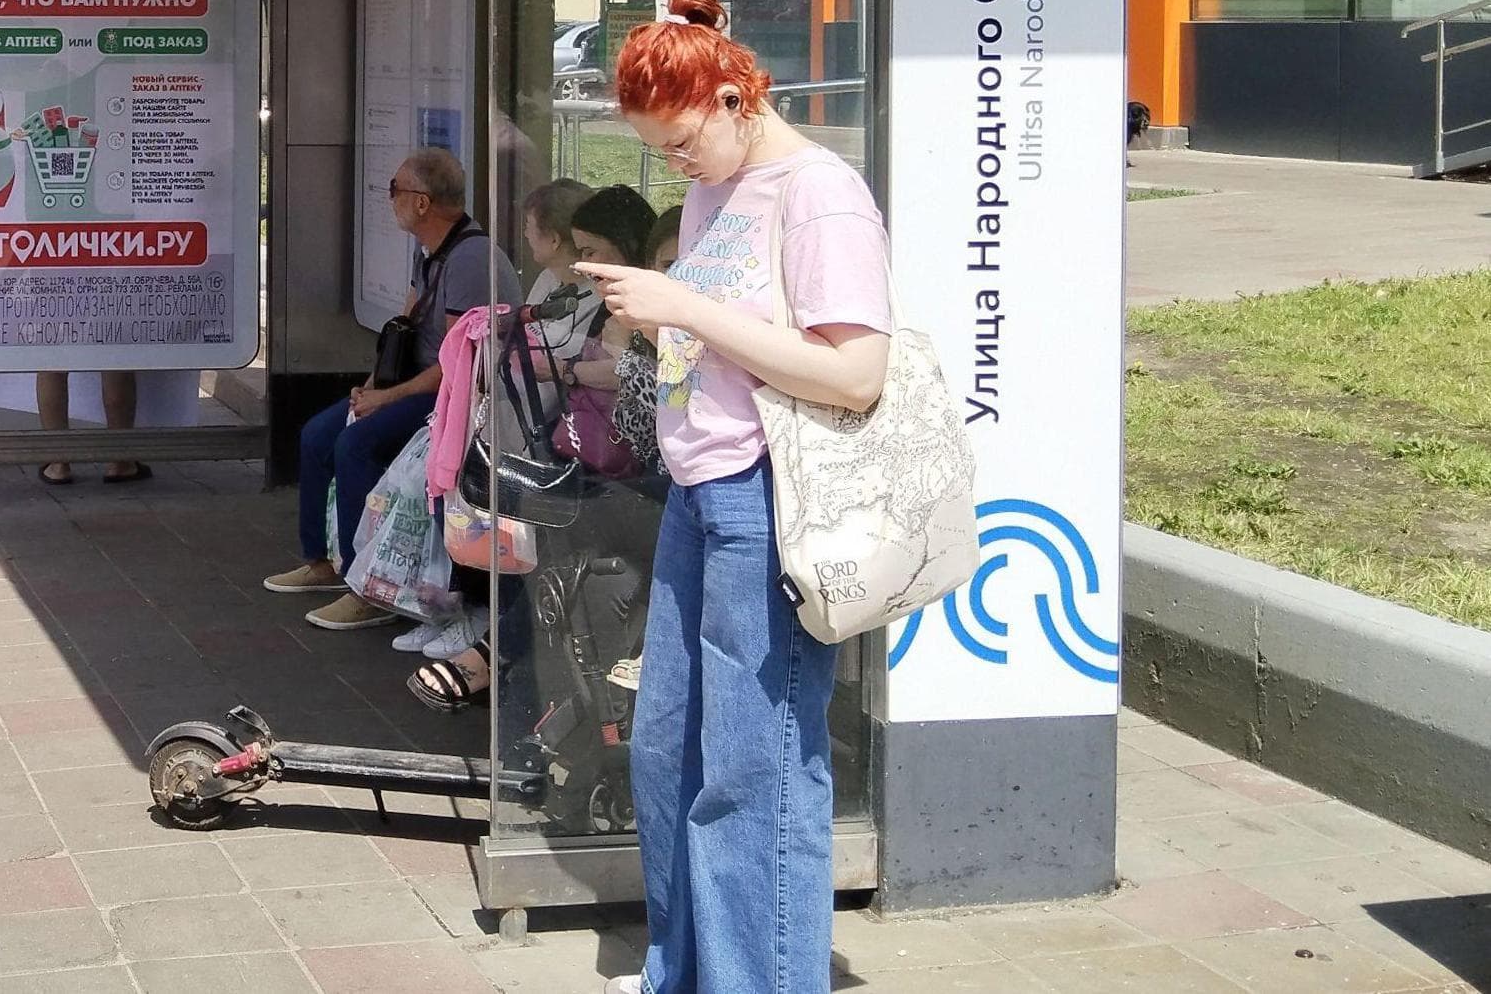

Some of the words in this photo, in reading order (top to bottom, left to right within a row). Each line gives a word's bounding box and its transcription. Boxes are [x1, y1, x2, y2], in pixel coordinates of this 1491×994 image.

[5, 35, 58, 48] АПТЕКЕ
[68, 37, 93, 48] ИЛИ
[123, 35, 155, 50] ПОД
[158, 35, 204, 49] ЗАКАЗ
[132, 74, 165, 83] НОВЫЙ
[167, 75, 199, 83] СЕРВИС
[967, 18, 1009, 271] Народного
[1018, 99, 1044, 181] Ulitsa
[138, 294, 226, 317] НЕОБХОДИМО
[18, 321, 123, 345] КОНСУЛЬТАЦИИ
[131, 320, 225, 344] СПЕЦИАЛИСТА
[965, 289, 1005, 425] Улица
[812, 560, 858, 588] LORD
[818, 580, 867, 605] RINGS
